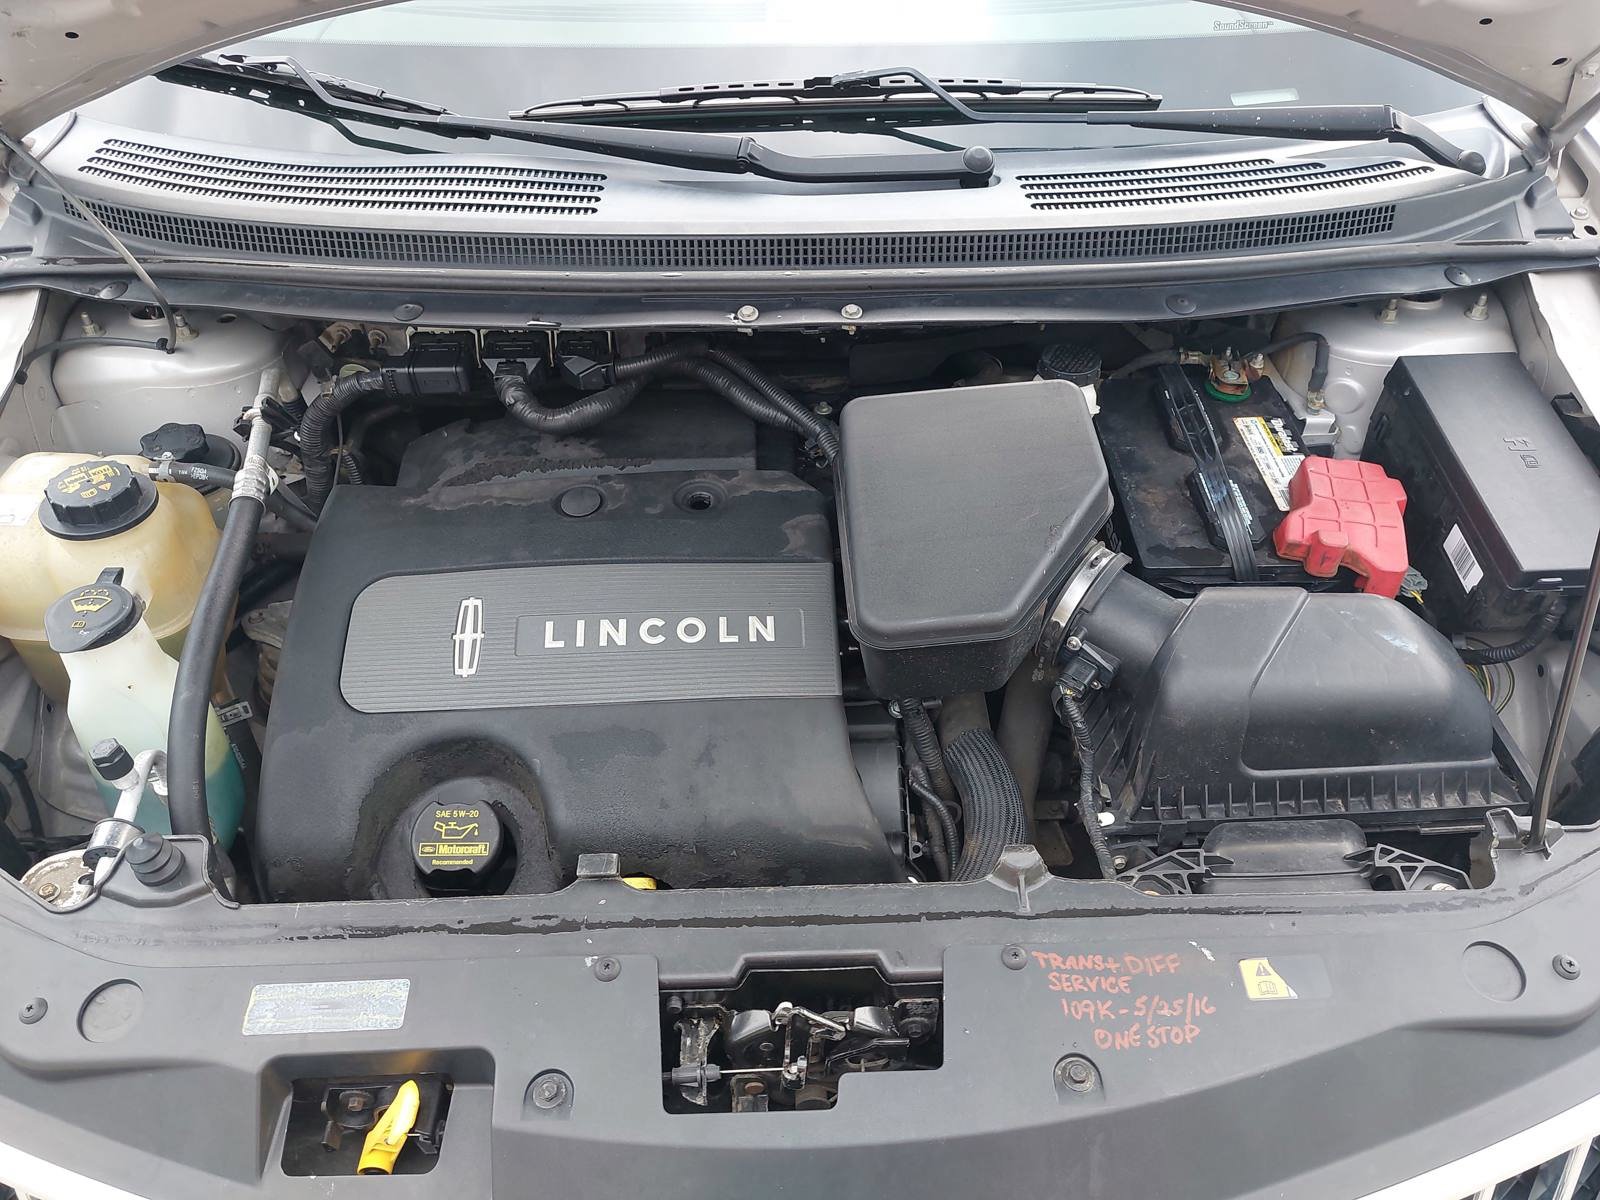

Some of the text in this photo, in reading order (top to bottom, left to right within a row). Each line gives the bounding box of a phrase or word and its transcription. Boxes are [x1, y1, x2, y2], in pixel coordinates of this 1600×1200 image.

[1270, 418, 1298, 452] Duralast
[544, 615, 777, 649] LINCOLN
[435, 810, 479, 818] SAE 5W-20
[438, 844, 487, 855] Motorcraft
[1123, 953, 1182, 976] DIFF
[1048, 972, 1133, 994] SERVICE
[1094, 1024, 1201, 1050] ONE STOP
